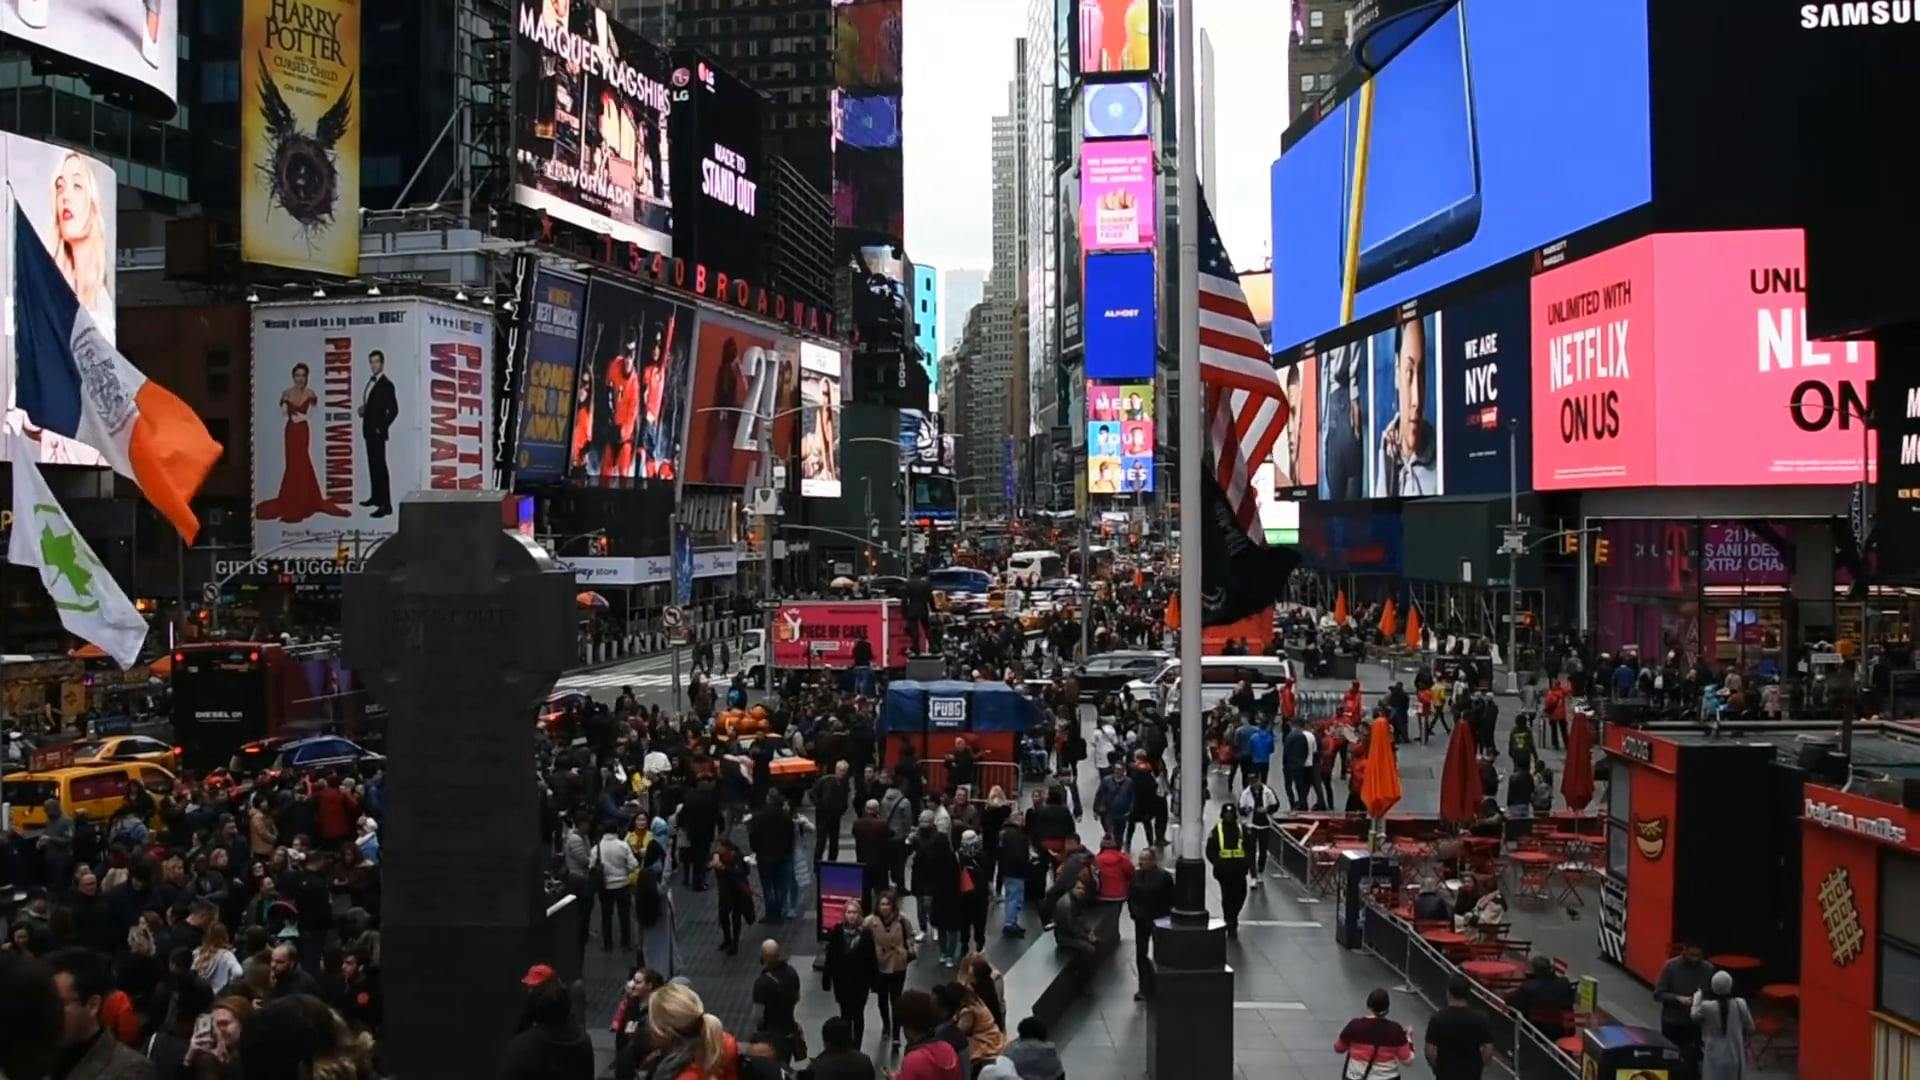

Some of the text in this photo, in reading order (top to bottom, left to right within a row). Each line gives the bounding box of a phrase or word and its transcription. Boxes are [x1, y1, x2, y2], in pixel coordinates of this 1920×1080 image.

[271, 0, 342, 40] HARRY
[1801, 0, 1920, 29] SAMSU
[265, 16, 346, 67] POTTER
[519, 2, 672, 116] MARQUEE FLAGSHIPS
[673, 90, 689, 101] LG
[705, 69, 715, 86] LG
[736, 154, 747, 174] TO
[570, 165, 632, 208] VORNADO
[702, 157, 757, 217] STAND OUT
[603, 233, 832, 338] 1540 BROADWAY
[1548, 278, 1631, 326] UNLIMITED WITH
[1104, 309, 1139, 318] ALMOST
[1464, 333, 1498, 360] WE ARE
[1550, 319, 1629, 393] NETFLIX
[324, 337, 353, 412] PRETTY
[530, 360, 573, 389] COME
[1465, 363, 1498, 405] NYC
[430, 343, 457, 489] WOMAN
[458, 343, 483, 490] PRETTY
[733, 346, 779, 451] 21
[1096, 398, 1144, 410] MEET
[1560, 390, 1619, 443] ON US
[1790, 380, 1877, 432] ON
[524, 412, 567, 442] AWAY
[325, 423, 353, 504] WOMAN
[215, 560, 268, 575] GIFTS
[596, 568, 618, 576] store
[800, 624, 868, 638] PIECE OF CAKE
[934, 702, 961, 717] PUBG
